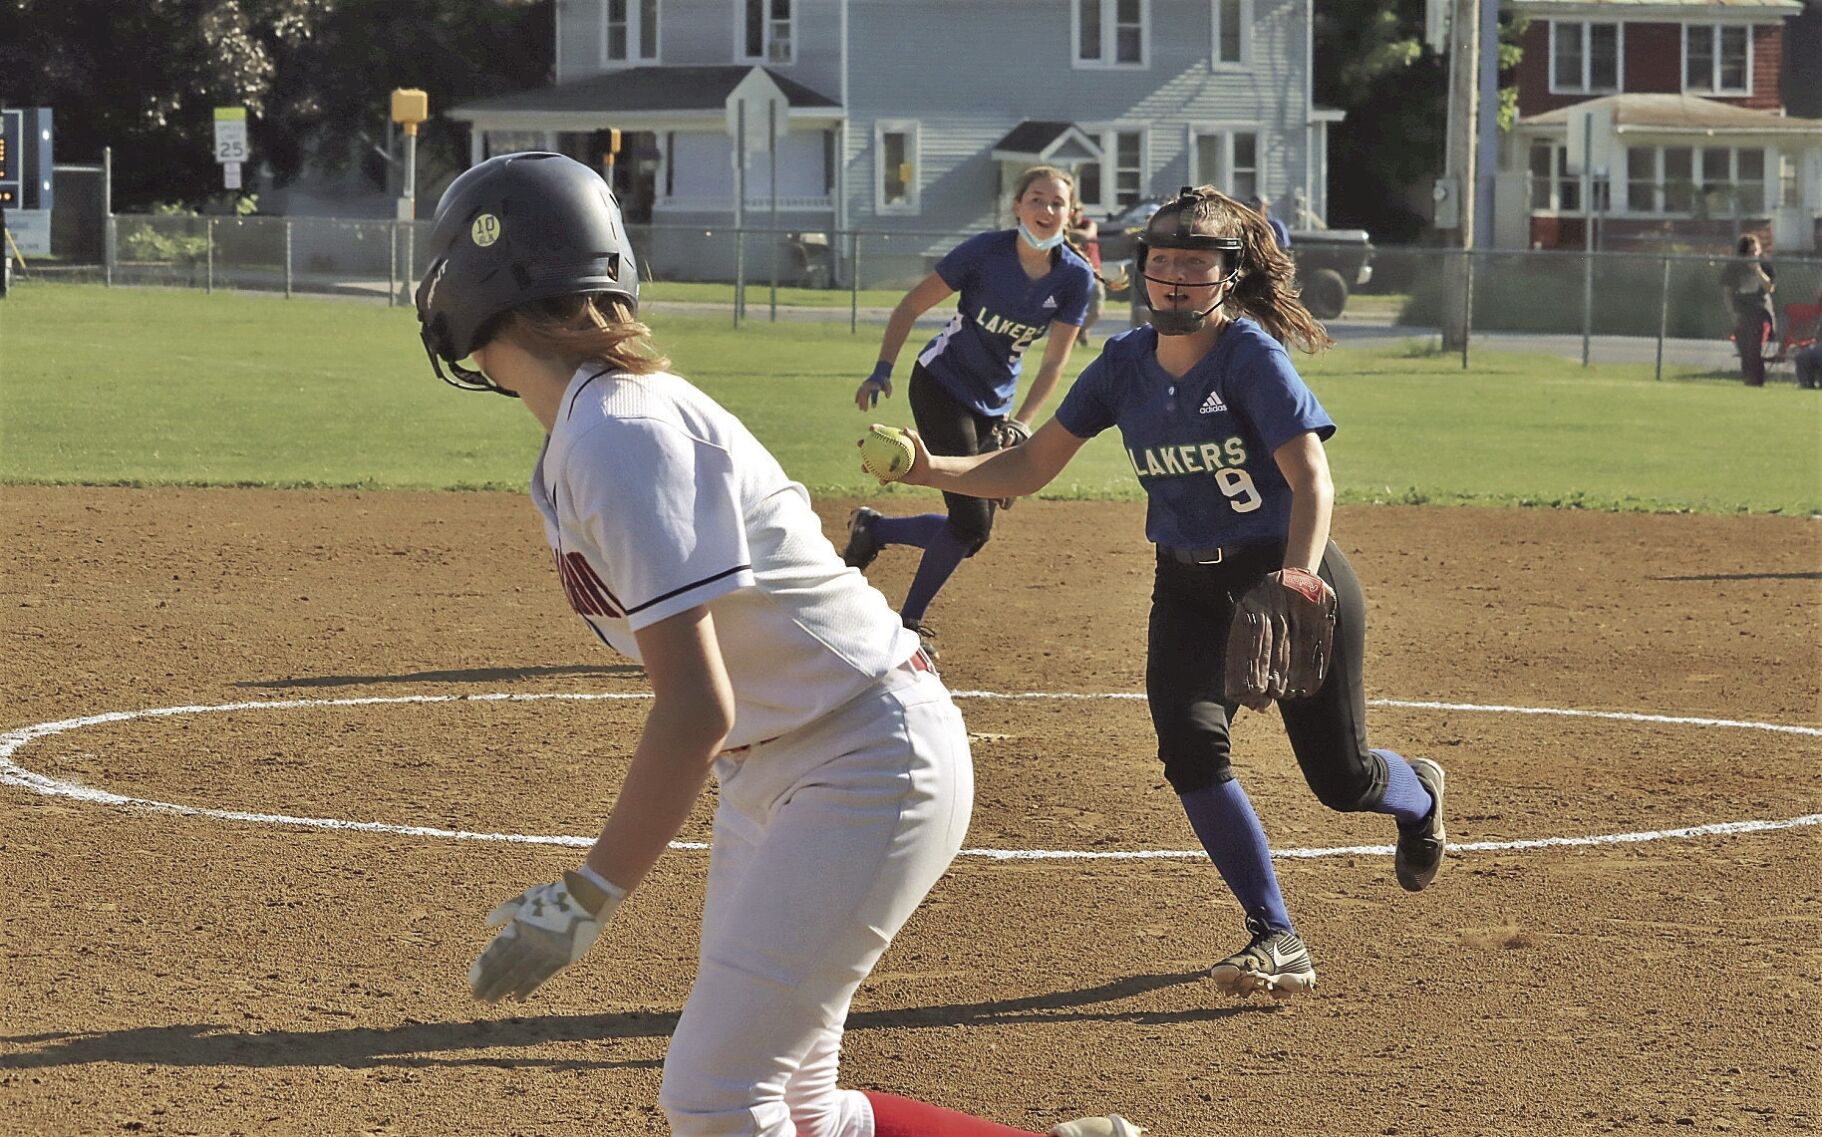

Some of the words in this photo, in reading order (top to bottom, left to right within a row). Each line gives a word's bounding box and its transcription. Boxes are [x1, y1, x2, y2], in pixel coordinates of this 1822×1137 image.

[220, 142, 243, 157] 25
[477, 216, 495, 234] 10
[1200, 404, 1228, 414] adidas
[1128, 436, 1247, 476] LAKERS
[1214, 467, 1262, 513] 9
